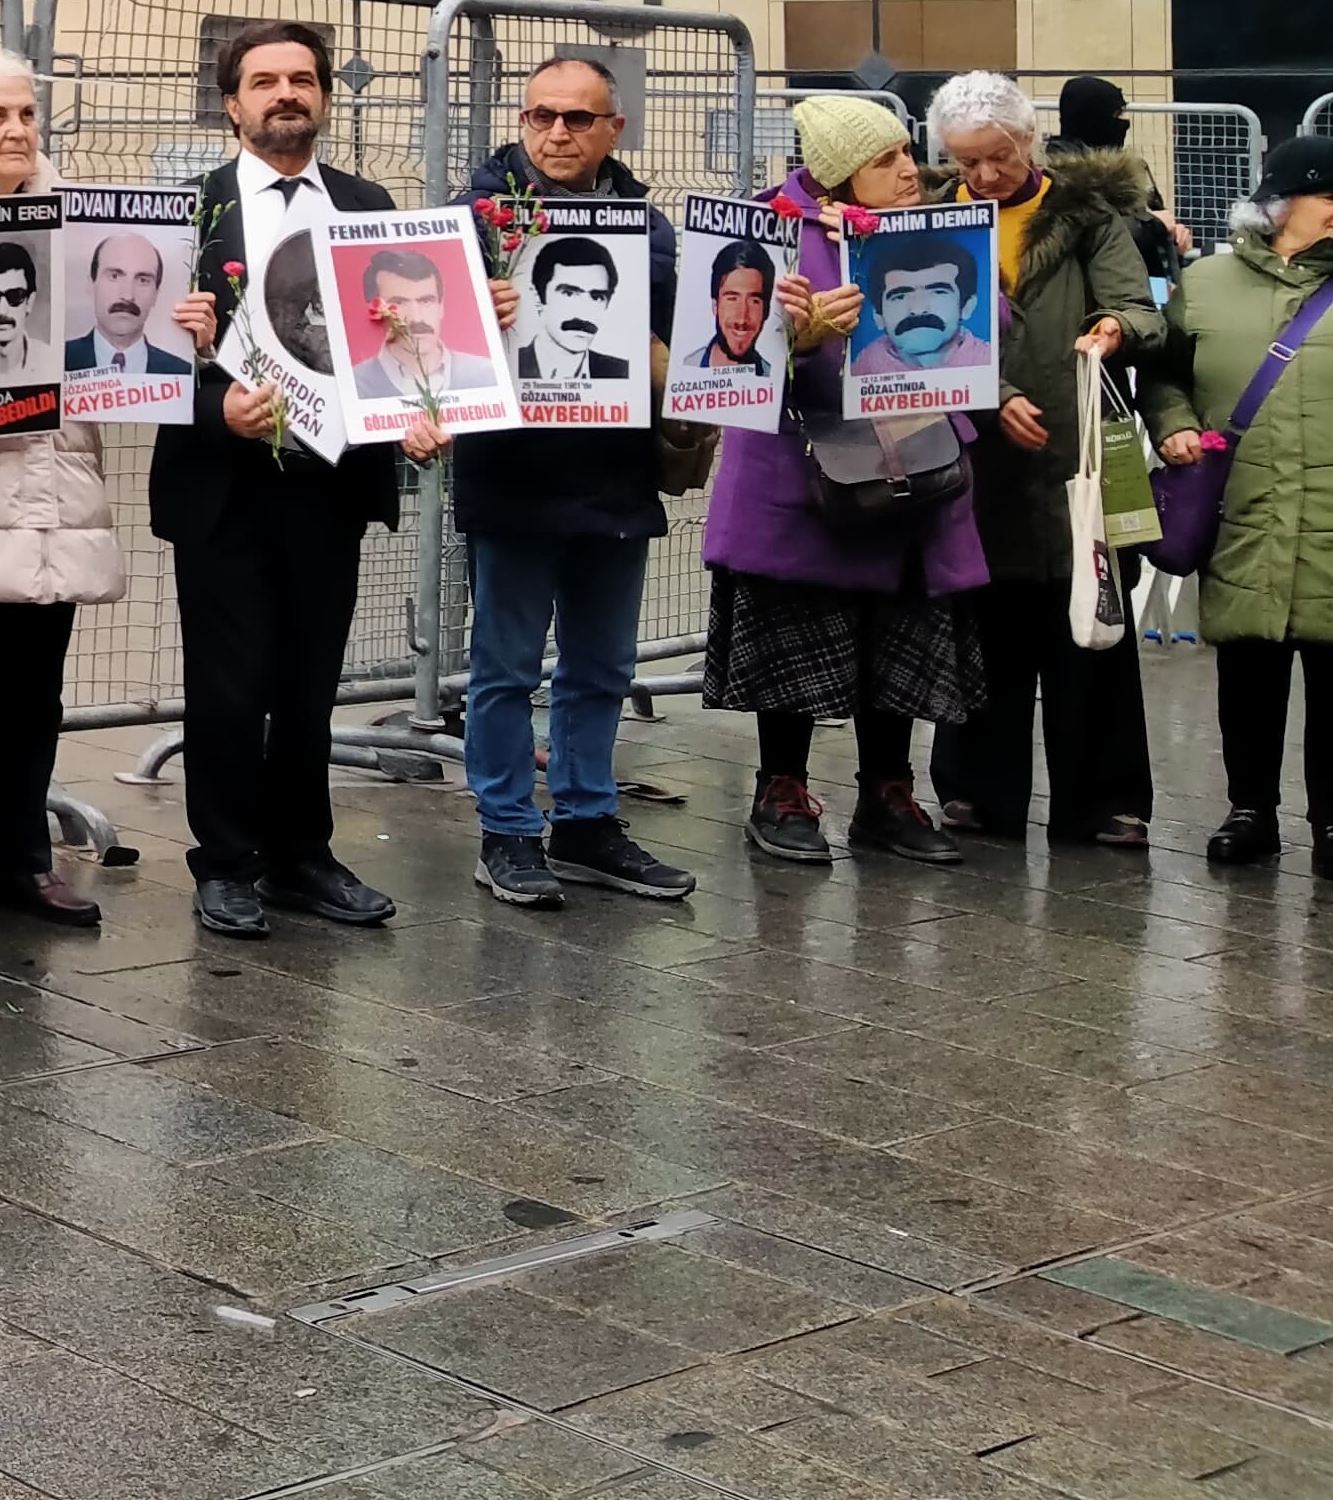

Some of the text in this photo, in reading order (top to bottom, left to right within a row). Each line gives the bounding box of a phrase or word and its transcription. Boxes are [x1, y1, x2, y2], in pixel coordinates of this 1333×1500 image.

[18, 204, 58, 221] EREN
[120, 193, 195, 226] KARAKOÇ
[595, 206, 645, 227] CİHAN
[932, 206, 990, 230] DEMİR
[328, 218, 461, 241] FEHMİ TOSUN
[689, 198, 797, 246] HASAN OCAK
[63, 375, 182, 417] KAYBEDİLDİ
[520, 390, 582, 402] GÖZALTINDA
[670, 378, 734, 393] GÖZALTINDA
[671, 382, 774, 413] KAYBEDİLDİ
[860, 381, 926, 396] GÖZALTINDA
[860, 384, 970, 413] KAYBEDİLDİ
[519, 399, 629, 423] KAYBEDİLDİ
